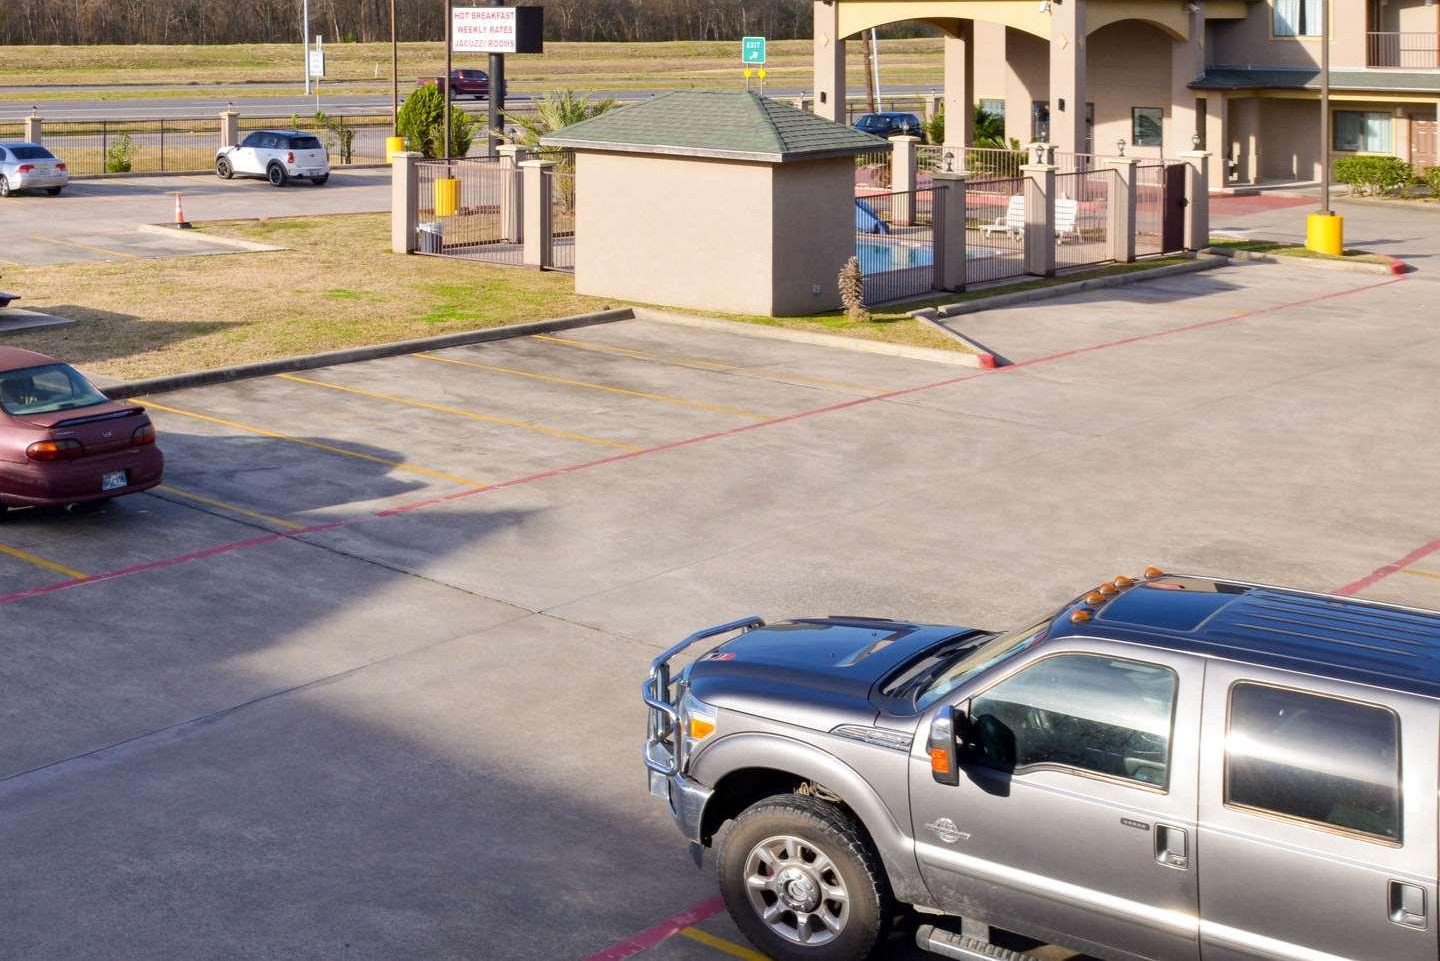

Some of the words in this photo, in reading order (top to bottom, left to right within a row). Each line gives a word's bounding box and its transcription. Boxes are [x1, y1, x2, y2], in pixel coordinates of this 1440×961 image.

[455, 12, 469, 20] HOT
[472, 12, 514, 20] BREAKFAST
[458, 26, 487, 34] WEEKLY
[489, 26, 512, 34] RATES
